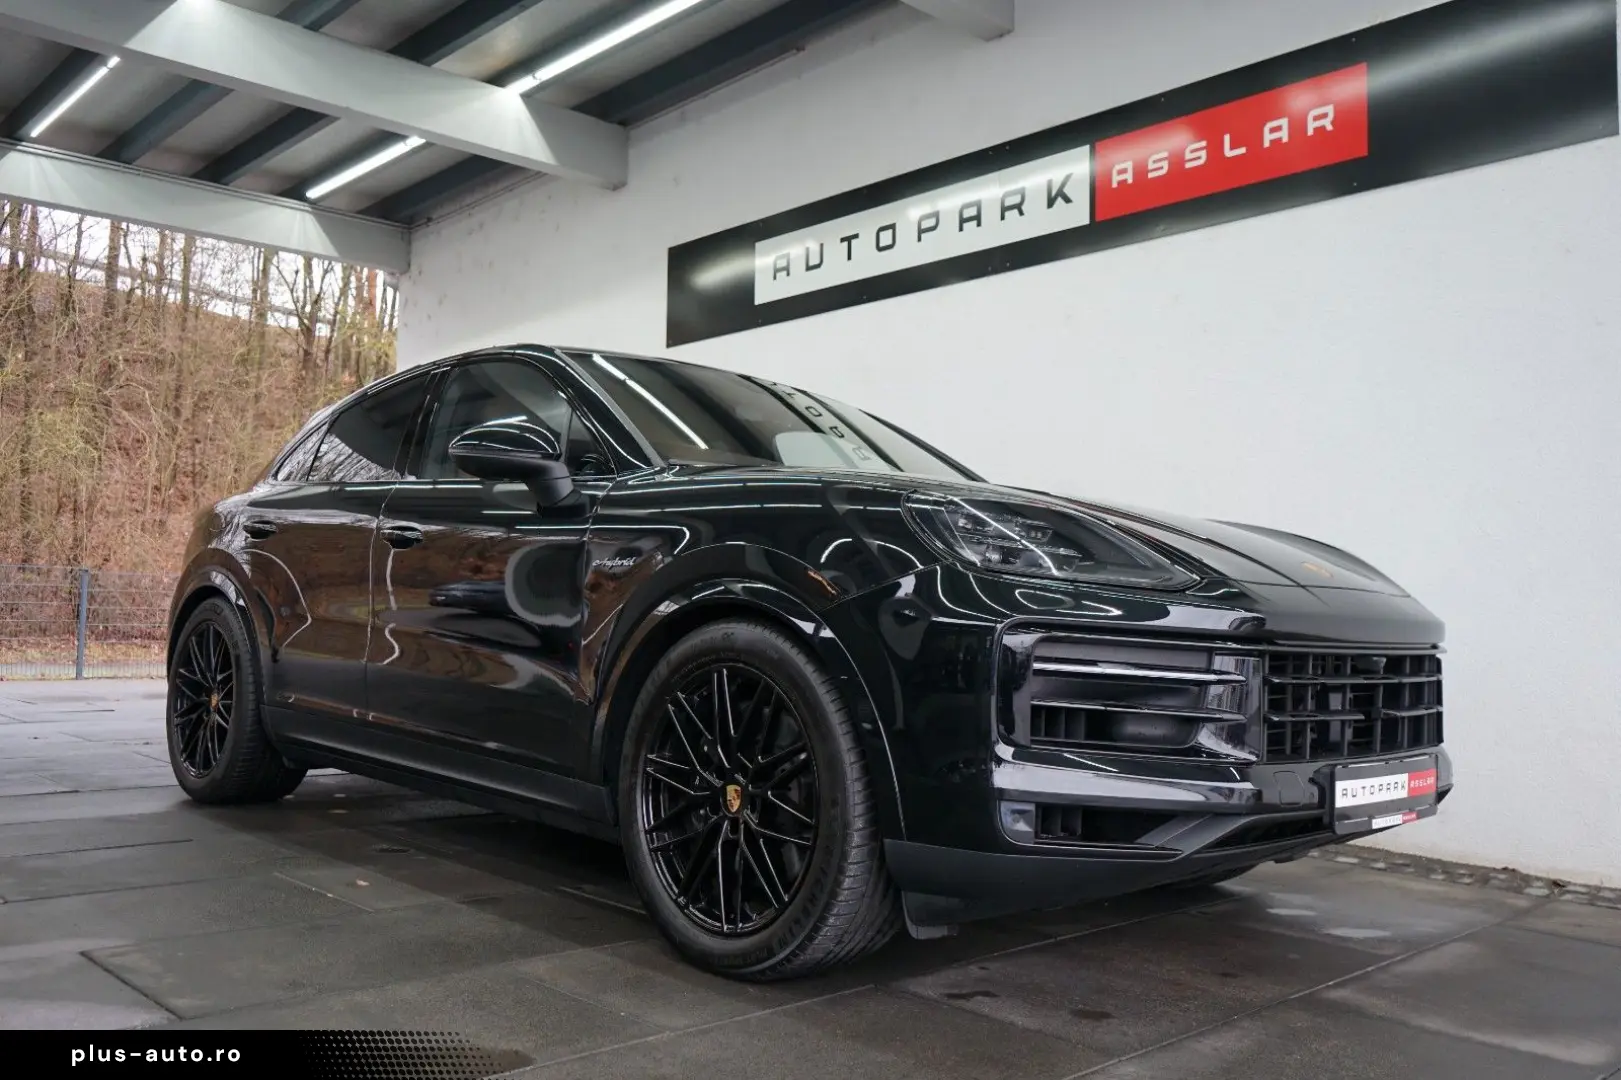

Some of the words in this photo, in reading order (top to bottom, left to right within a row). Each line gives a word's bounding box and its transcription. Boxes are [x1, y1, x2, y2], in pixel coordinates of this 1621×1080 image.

[772, 172, 1074, 281] AUTOPARK
[1111, 103, 1335, 188] ASSLAR
[1341, 780, 1406, 798] AUTOPARK
